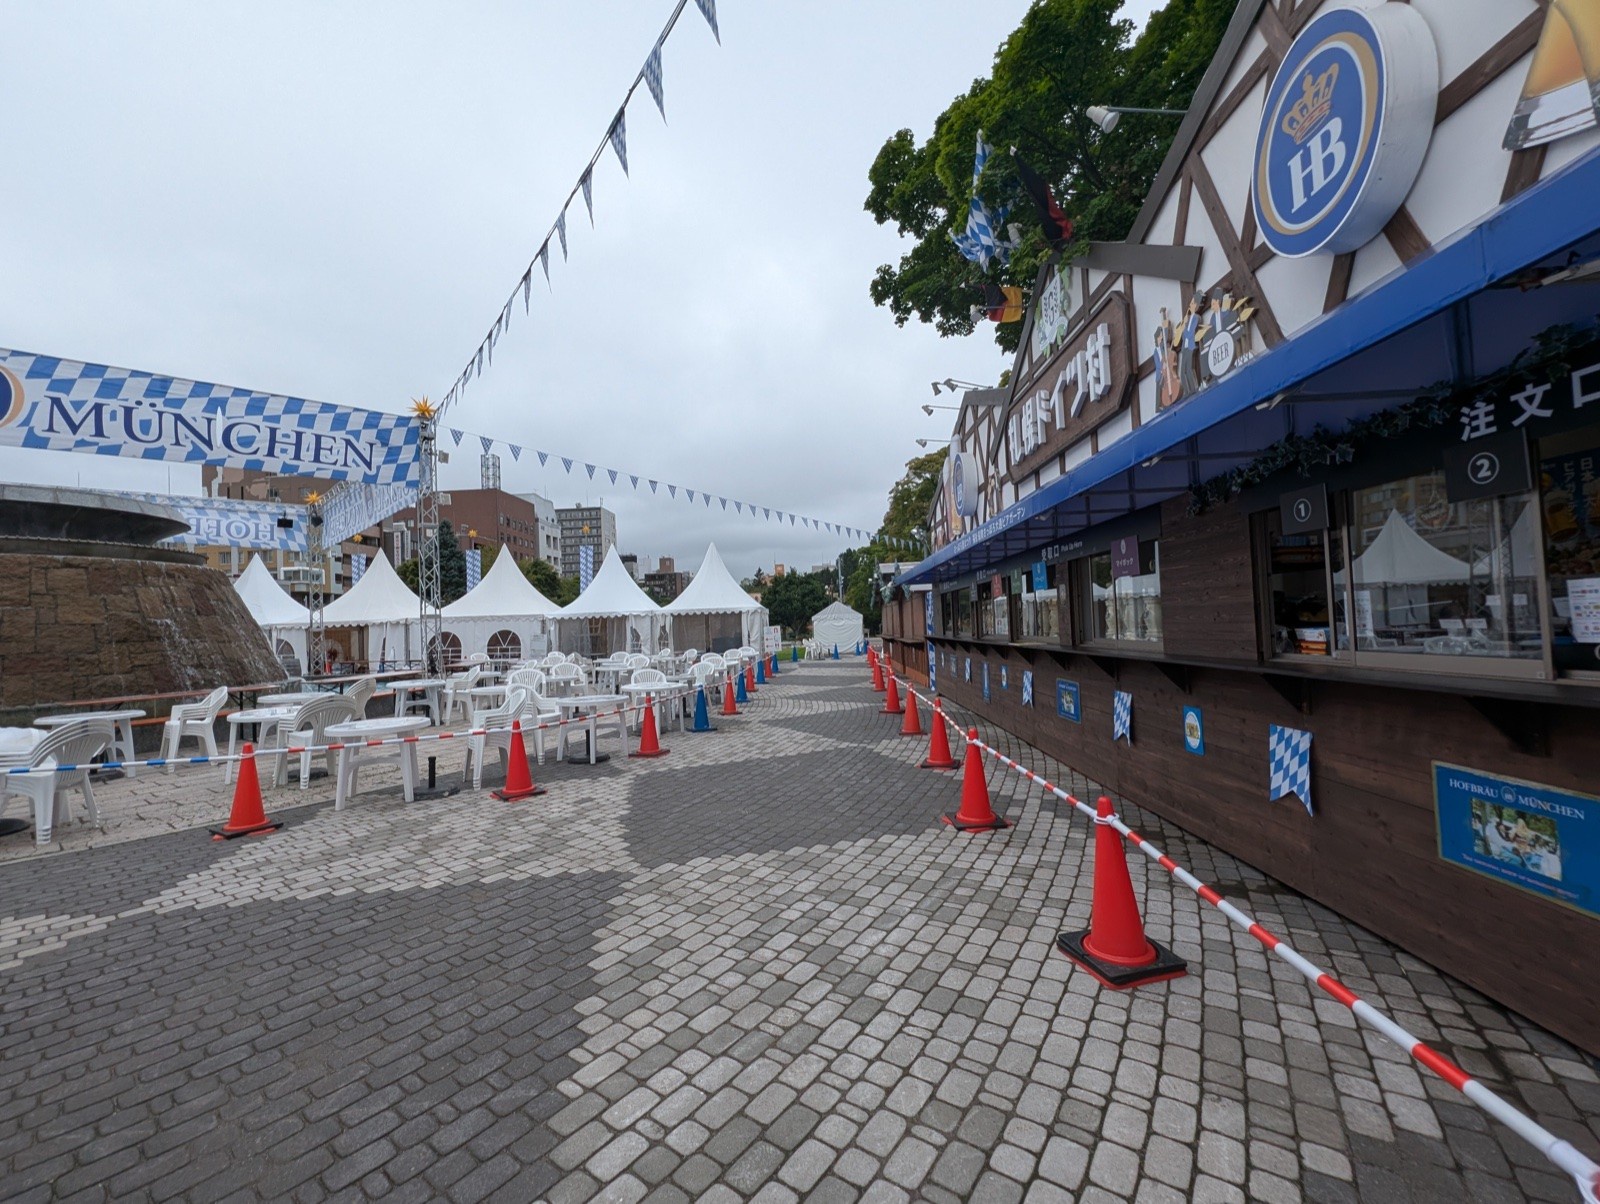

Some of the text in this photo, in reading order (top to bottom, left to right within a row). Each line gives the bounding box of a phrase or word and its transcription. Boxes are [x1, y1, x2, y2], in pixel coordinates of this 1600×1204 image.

[1286, 115, 1347, 215] HB
[1212, 342, 1230, 367] BEER
[1008, 323, 1112, 466] 札幌ドイツ村
[42, 396, 376, 472] MÜNCHEN
[1449, 778, 1499, 799] HOFBRÄU
[1518, 794, 1585, 820] MÜNCHEN
